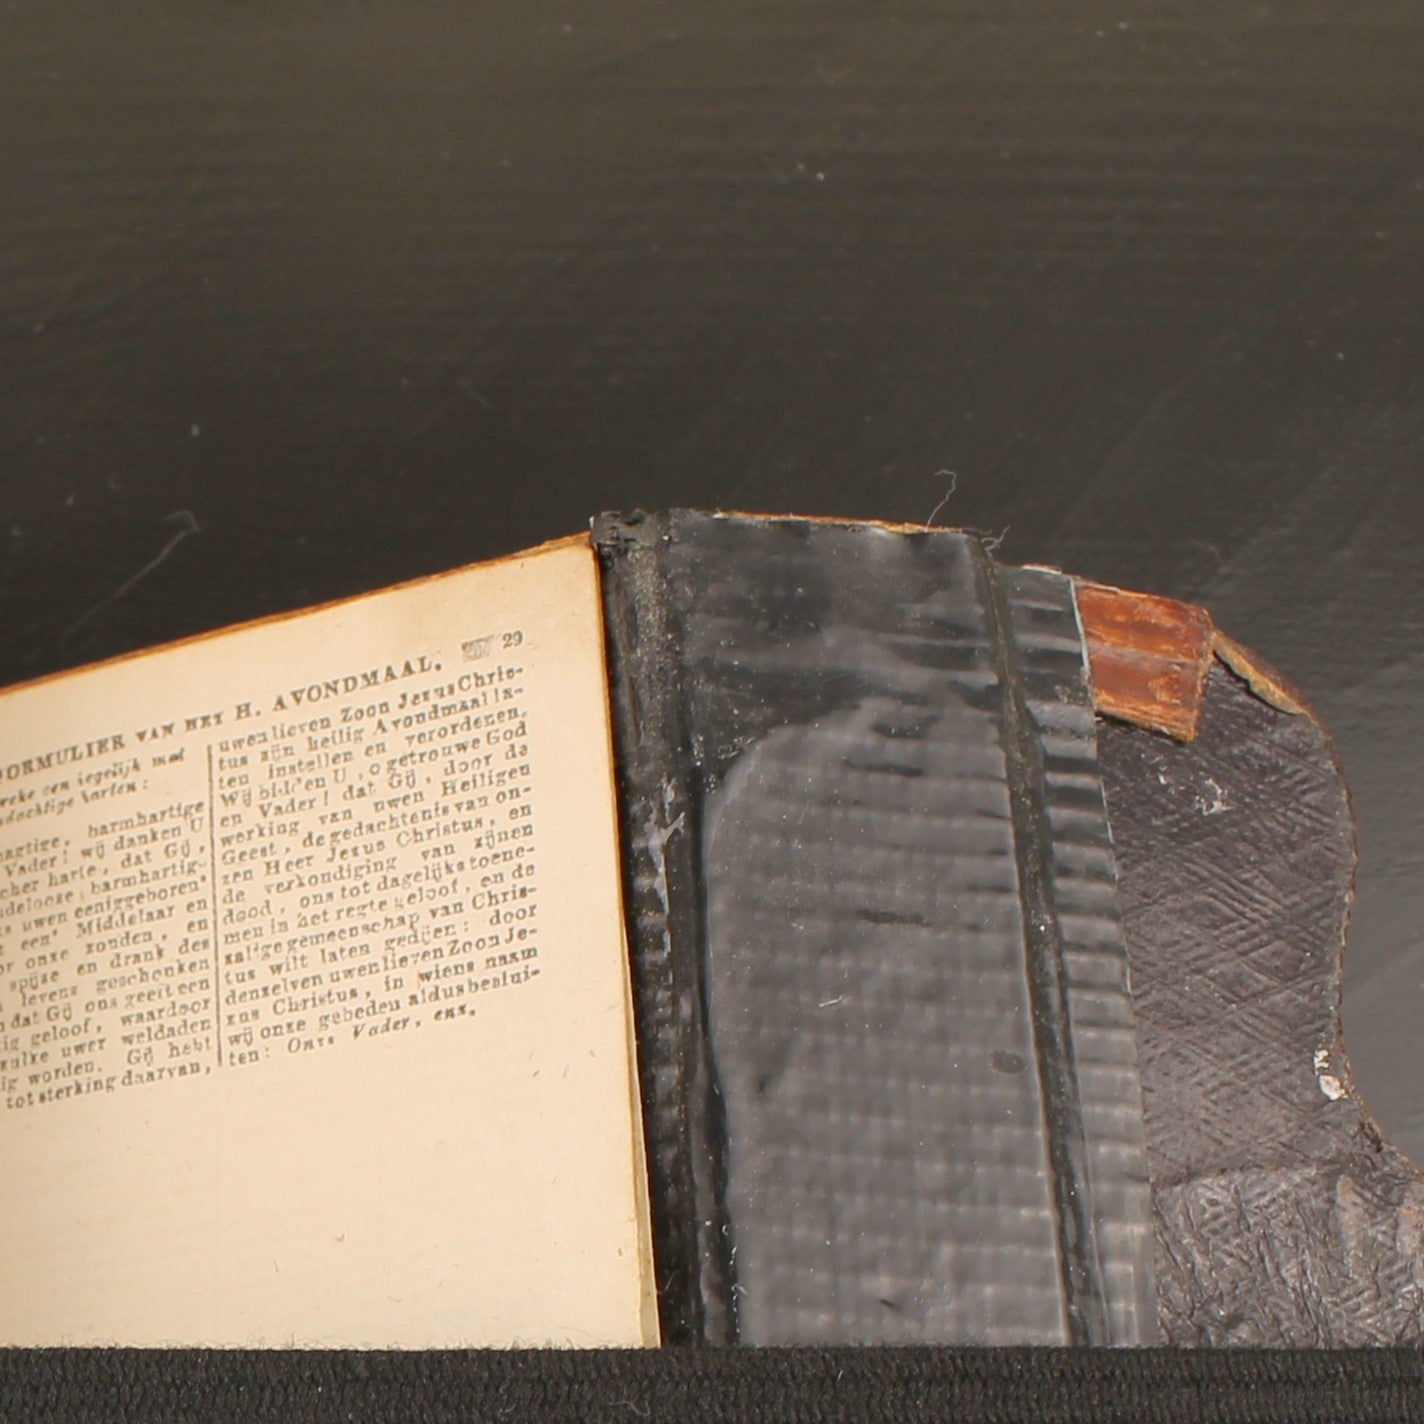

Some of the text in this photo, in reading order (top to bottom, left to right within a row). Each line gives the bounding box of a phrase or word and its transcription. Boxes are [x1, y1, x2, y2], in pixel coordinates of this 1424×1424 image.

[502, 630, 524, 650] 29
[235, 702, 261, 721] H.
[273, 655, 442, 711] AVONDMAAL.
[218, 813, 242, 827] en
[341, 781, 374, 800] dat
[442, 753, 493, 775] door
[503, 742, 530, 760] de
[219, 764, 531, 846] werking van uwen Heiligen
[79, 843, 105, 859] wij
[112, 826, 182, 850] danken
[189, 816, 204, 832] U
[221, 887, 245, 904] de
[420, 843, 455, 860] van
[473, 823, 535, 849] zijnen
[264, 854, 314, 875] Heer
[395, 817, 495, 846] Christus,
[507, 804, 534, 819] en
[75, 905, 174, 936] Middelaar
[185, 898, 208, 913] en
[119, 998, 211, 1025] waardoor
[5, 1091, 34, 1109] tot
[37, 1076, 116, 1103] sterking
[120, 1062, 212, 1086] daarvan,
